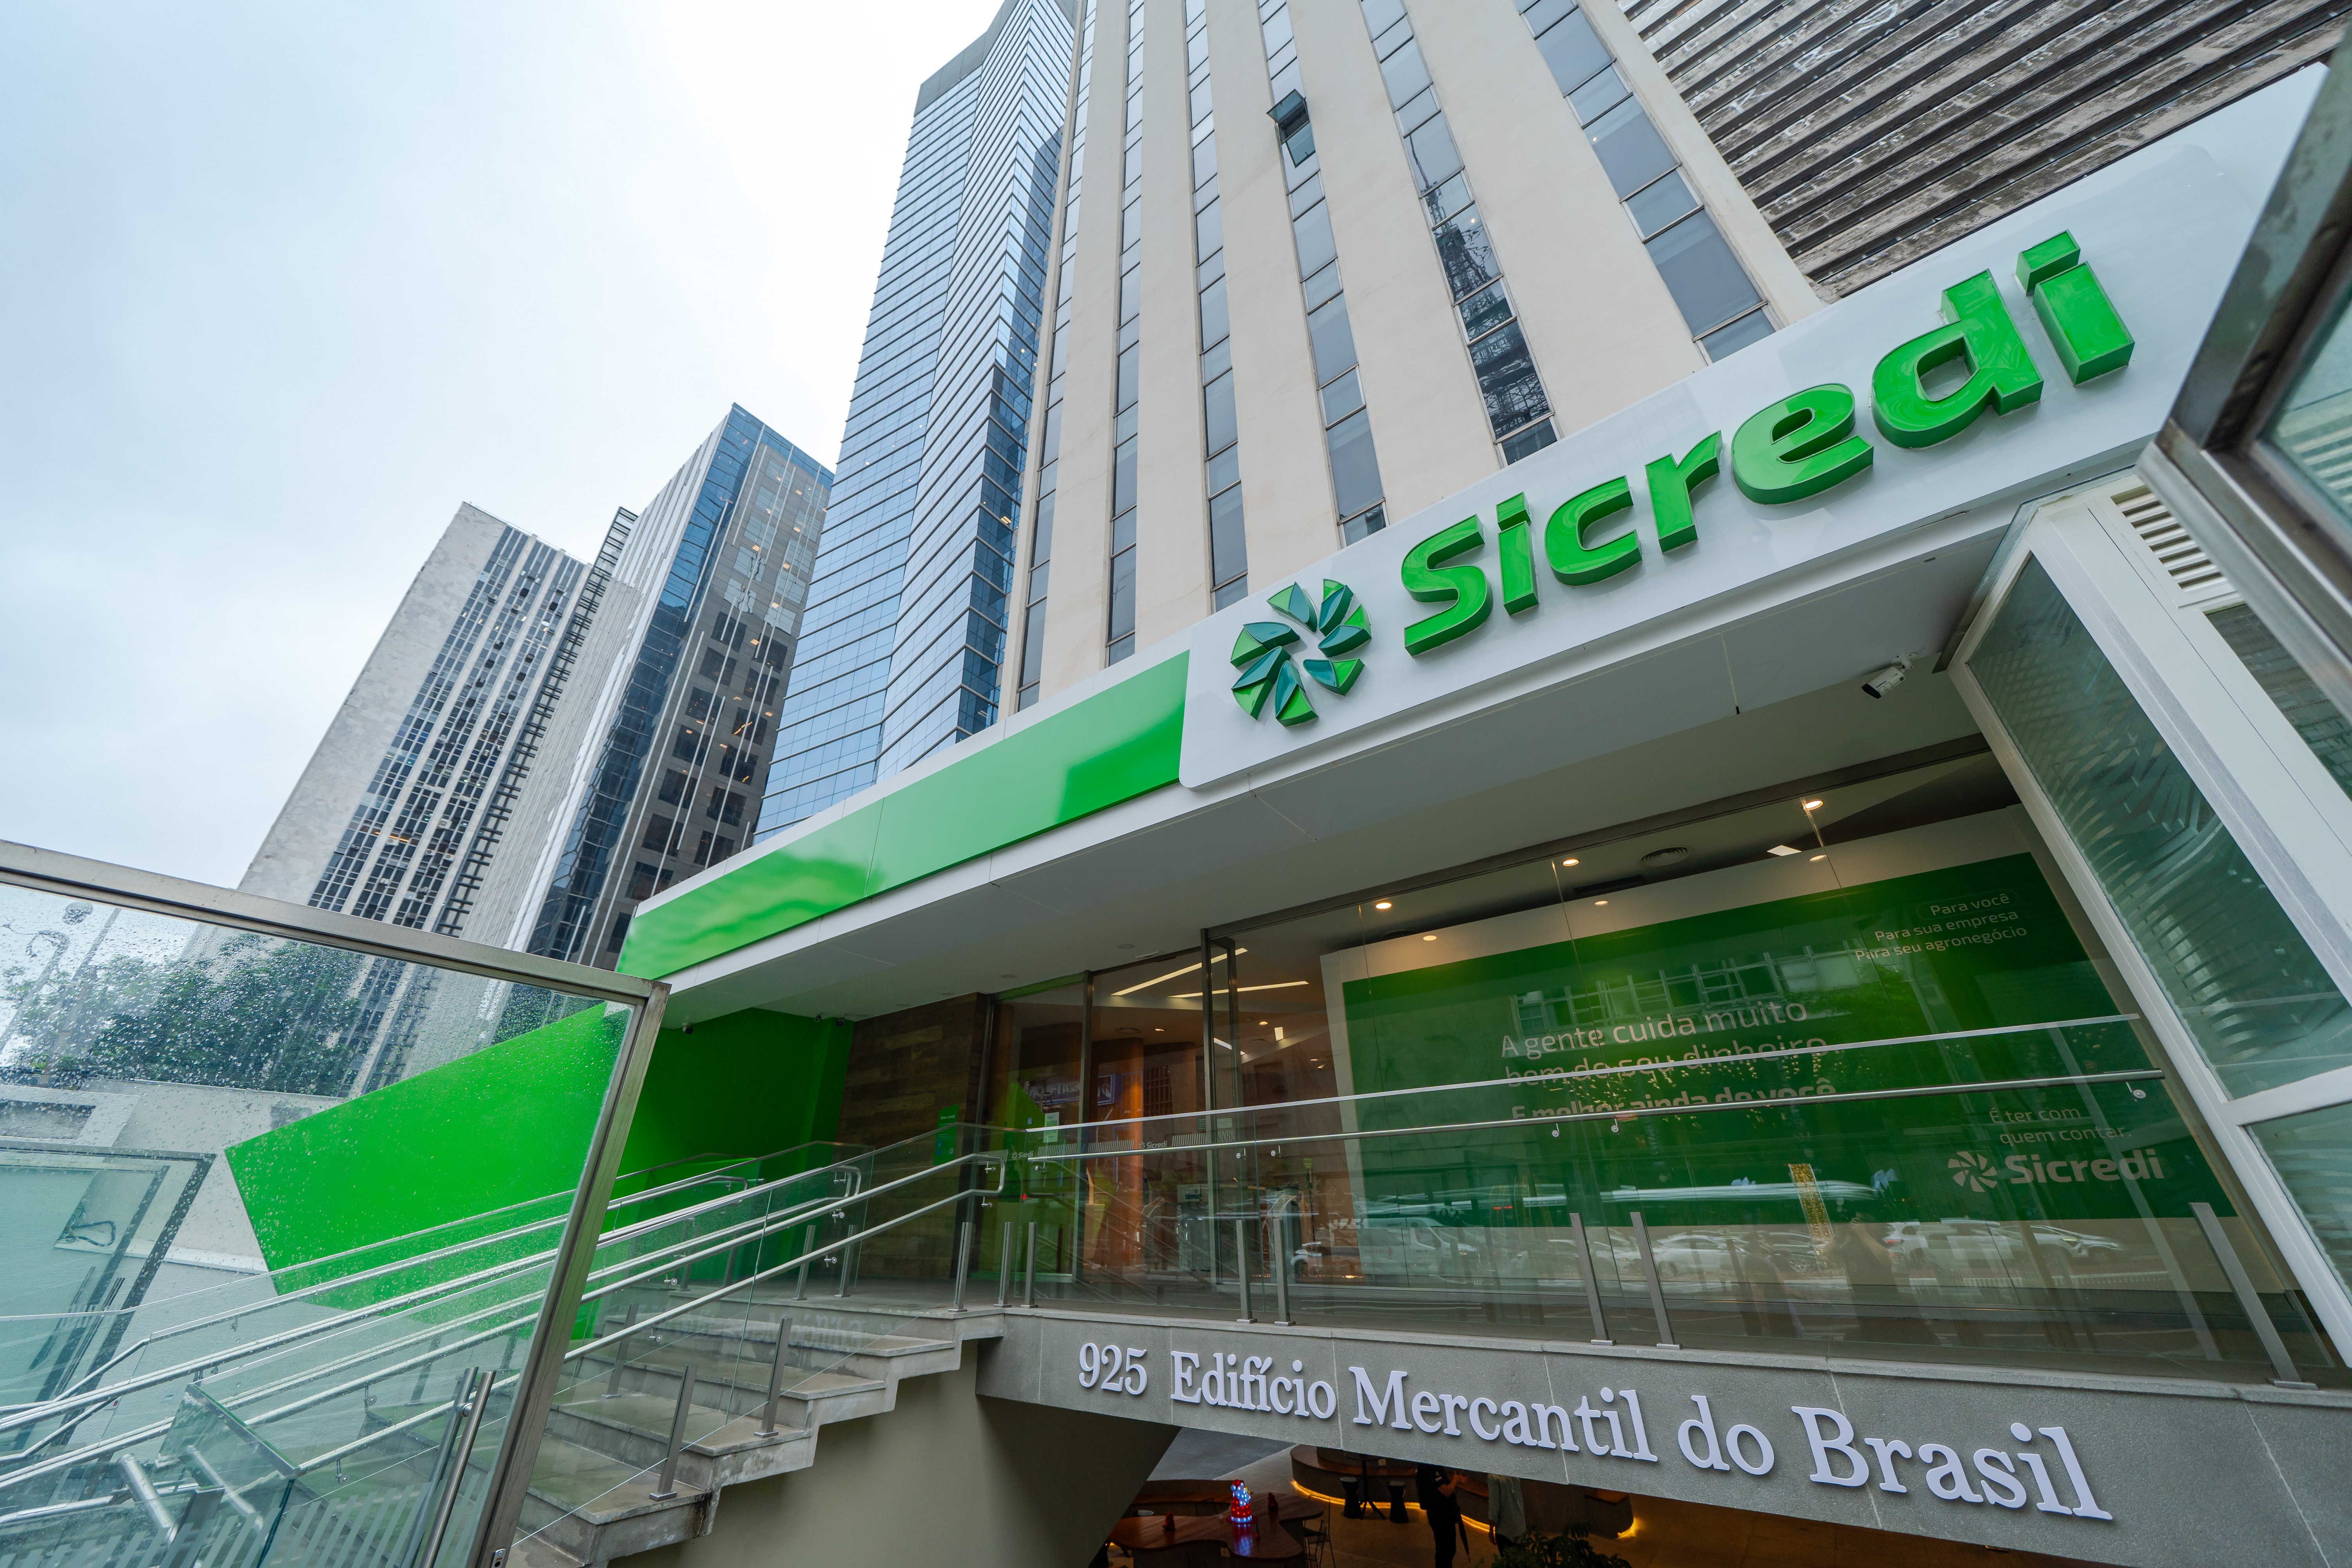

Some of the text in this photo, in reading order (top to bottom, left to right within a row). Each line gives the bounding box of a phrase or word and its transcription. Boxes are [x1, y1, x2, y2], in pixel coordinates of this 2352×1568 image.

[1401, 230, 2135, 657] Sicredi
[1930, 893, 2011, 916] Para você
[1875, 911, 2019, 942] Para sua empresa
[1855, 926, 2027, 961] Para seu agronegócio
[1501, 1001, 1807, 1060] A gente cuida muito
[1989, 1107, 2082, 1123] É ter com
[1146, 1140, 1167, 1149] Sicredi
[1999, 1125, 2132, 1147] quem contar.
[2005, 1149, 2164, 1184] Sicredi
[1079, 1343, 2113, 1520] 925 Edifício Mercantil do Brasil
